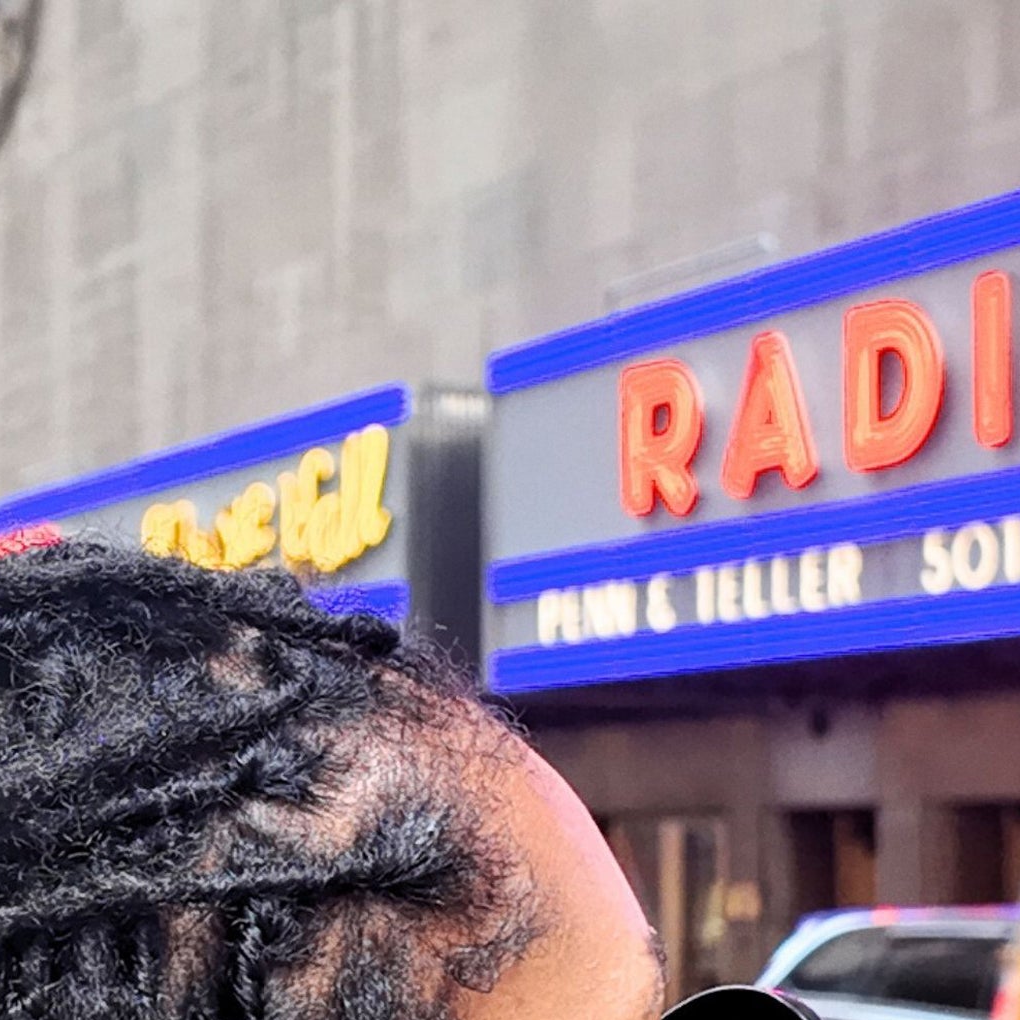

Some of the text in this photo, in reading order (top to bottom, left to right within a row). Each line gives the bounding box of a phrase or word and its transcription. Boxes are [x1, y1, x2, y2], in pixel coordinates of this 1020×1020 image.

[618, 269, 1013, 518] RADI
[537, 580, 637, 646] PENN
[646, 572, 677, 634] &
[696, 541, 863, 625] TELLER
